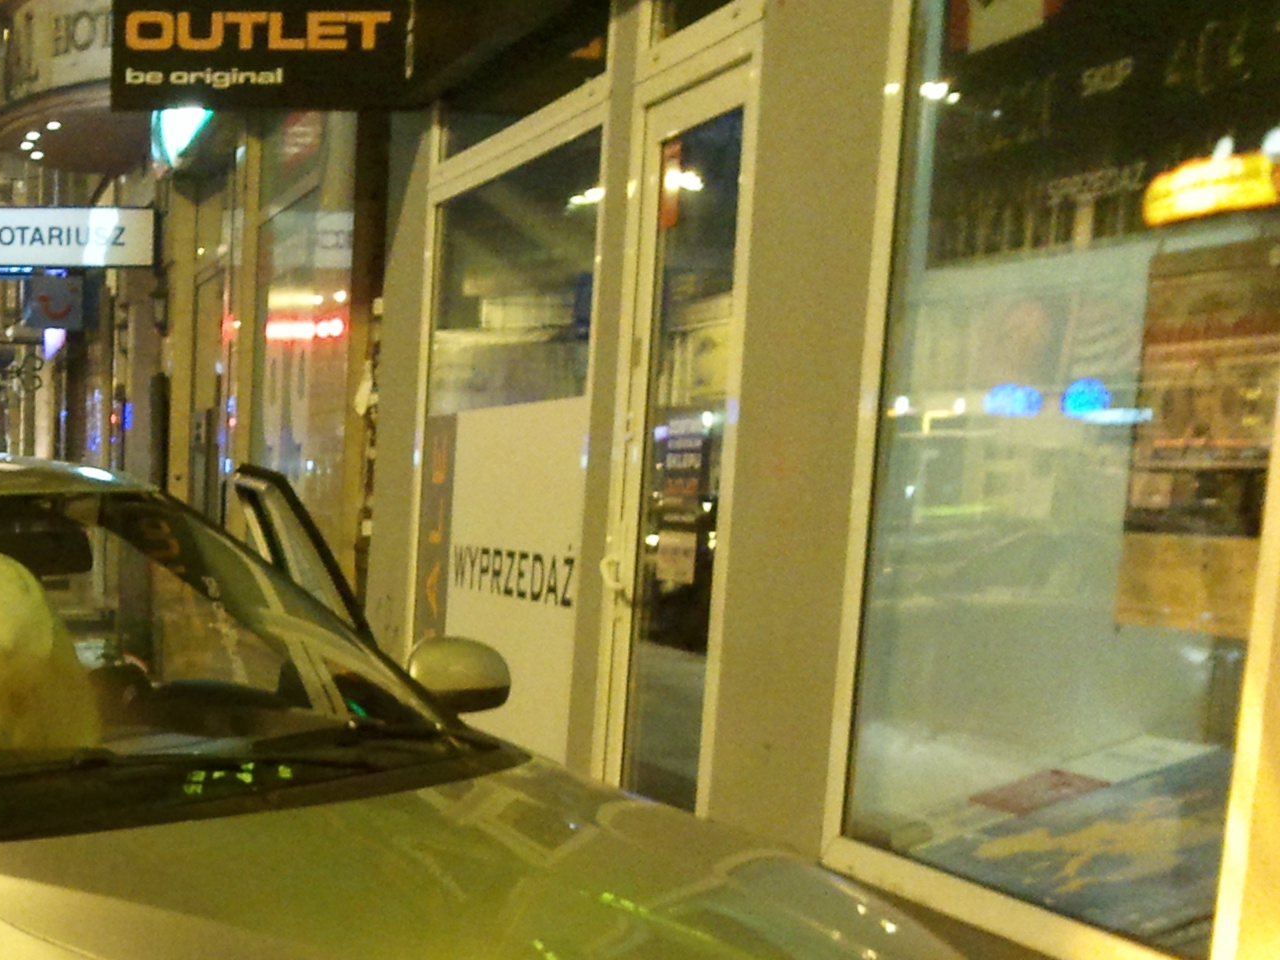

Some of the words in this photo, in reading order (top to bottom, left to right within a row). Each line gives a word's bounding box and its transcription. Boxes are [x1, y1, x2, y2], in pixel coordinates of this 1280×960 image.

[125, 10, 392, 51] OUTLET
[125, 67, 163, 84] be
[170, 67, 284, 88] original
[453, 544, 575, 608] WYPRZEDAŻ
